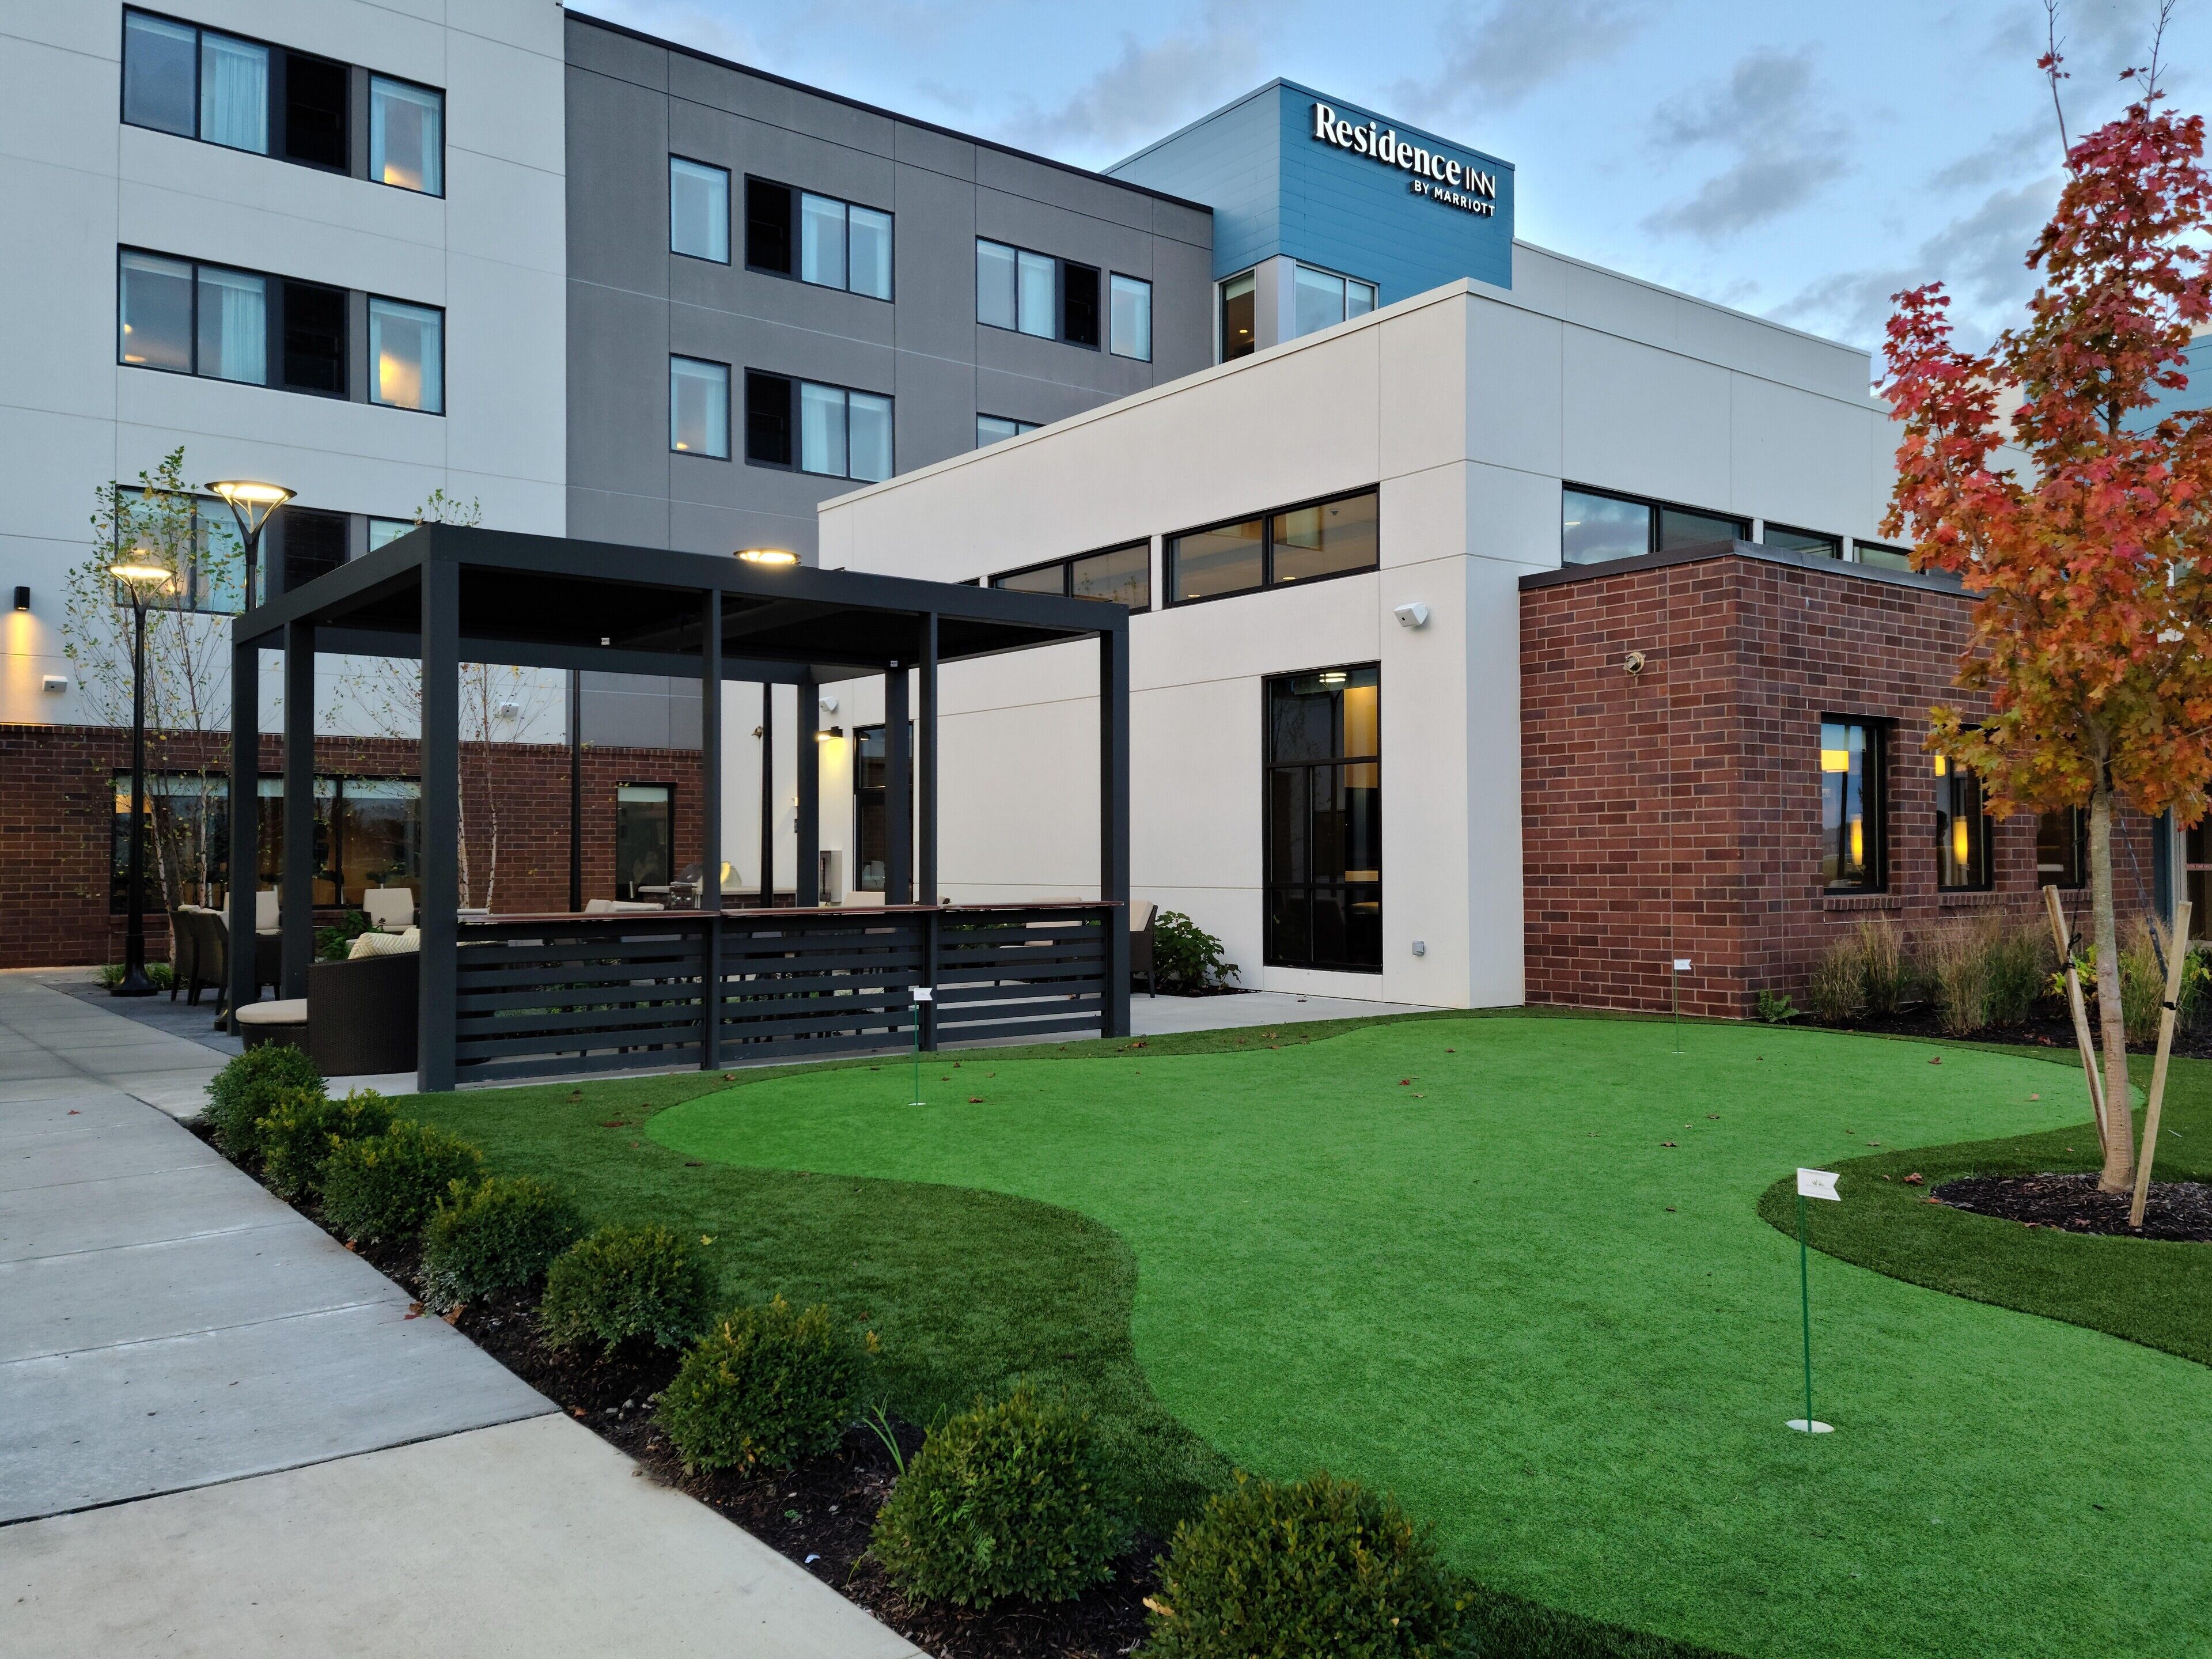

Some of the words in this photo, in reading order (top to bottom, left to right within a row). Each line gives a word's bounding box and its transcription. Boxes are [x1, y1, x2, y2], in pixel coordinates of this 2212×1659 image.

[1316, 103, 1461, 185] Residence
[1465, 166, 1495, 199] INN
[1414, 180, 1429, 194] BY
[1434, 188, 1495, 217] MARRIOTT
